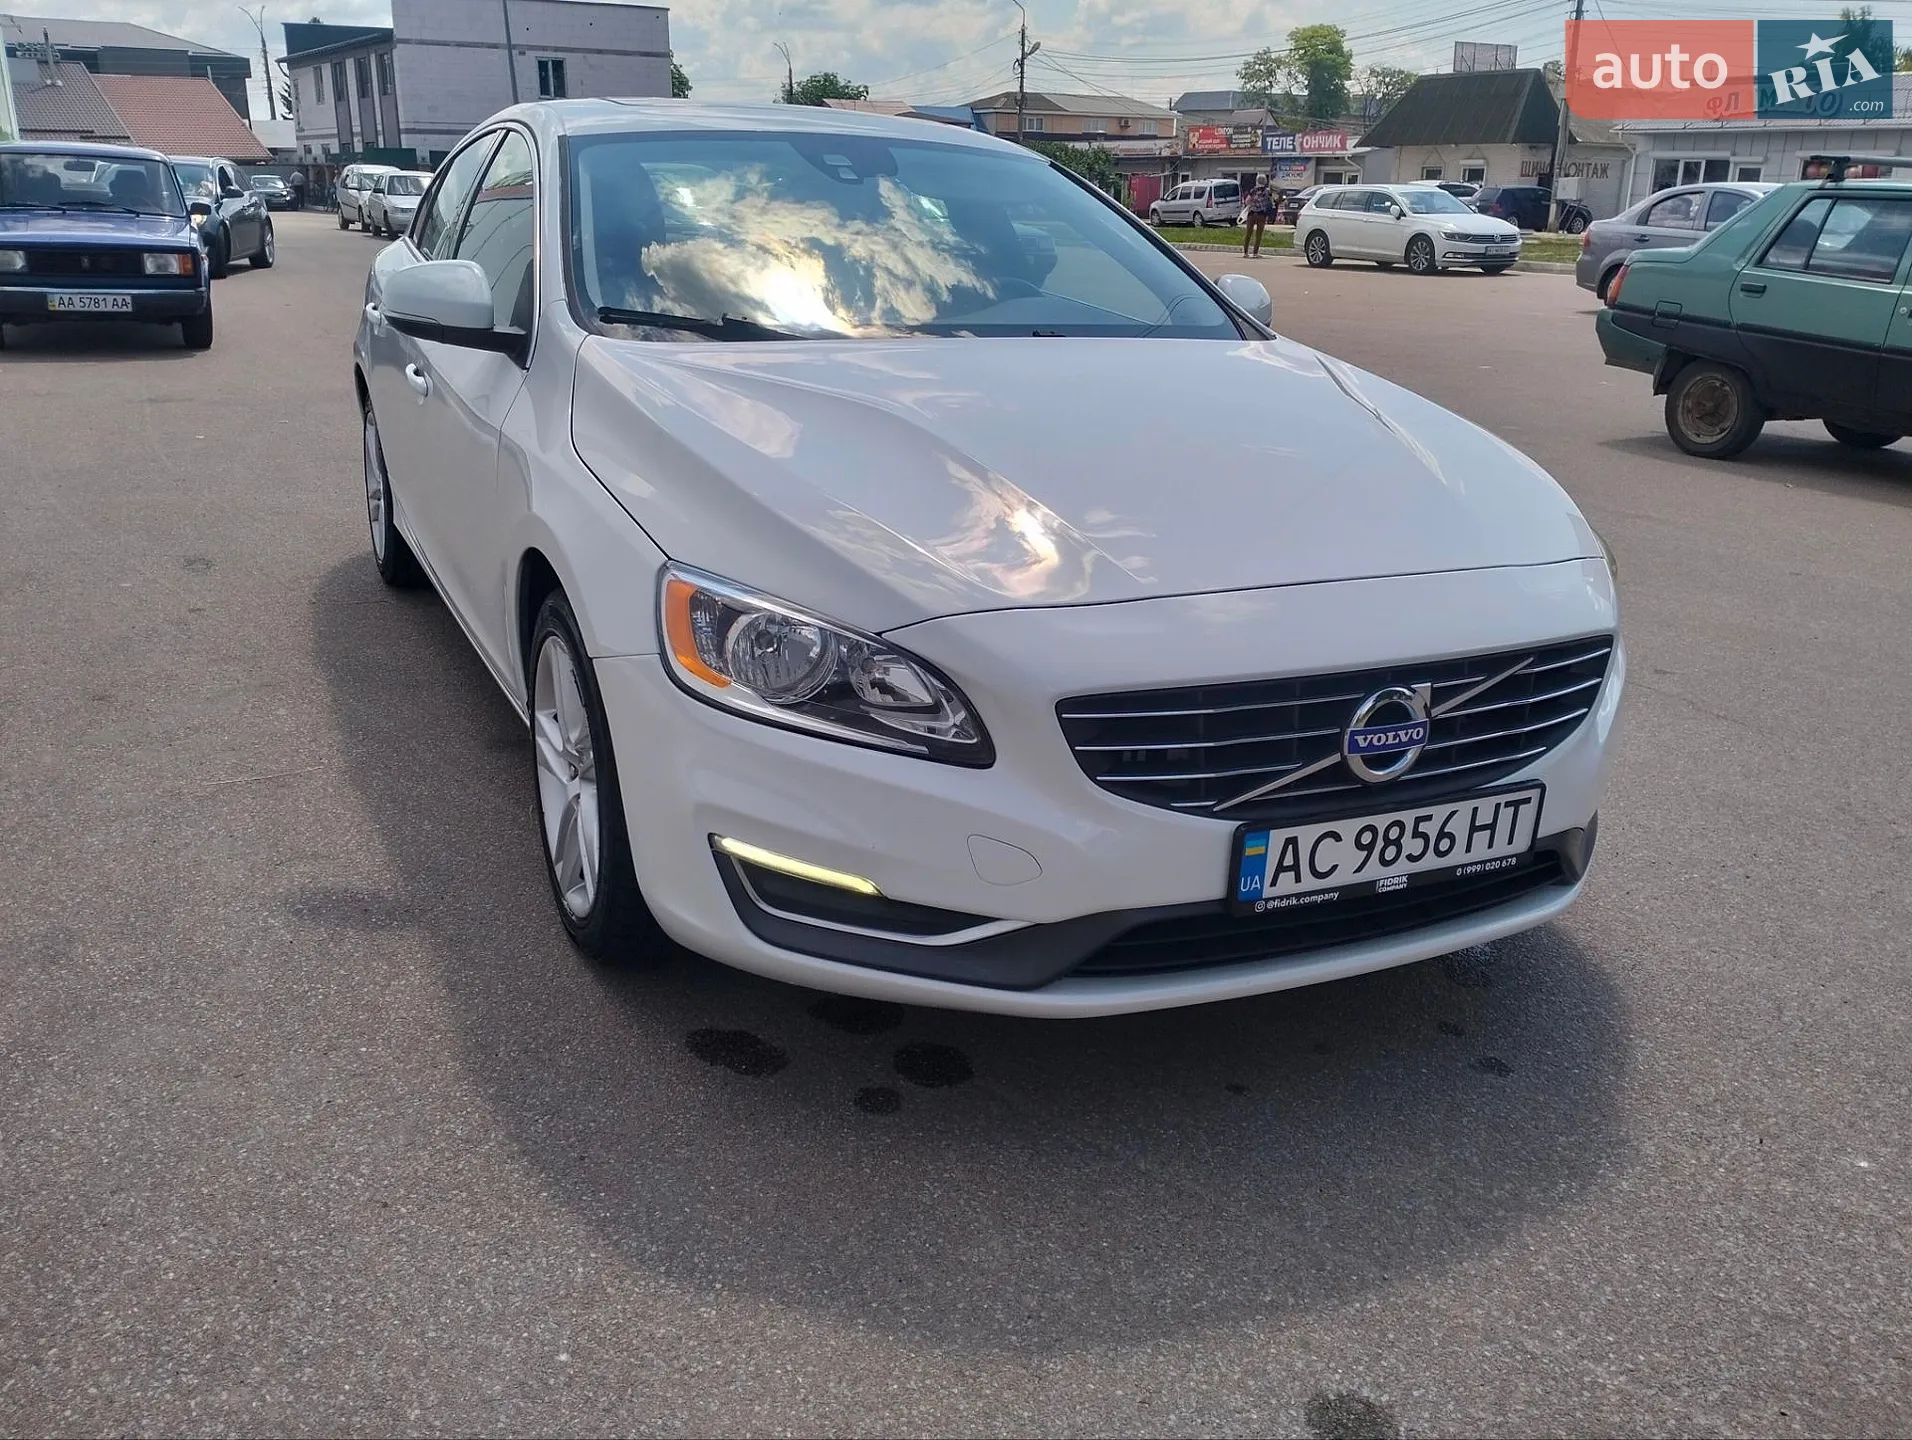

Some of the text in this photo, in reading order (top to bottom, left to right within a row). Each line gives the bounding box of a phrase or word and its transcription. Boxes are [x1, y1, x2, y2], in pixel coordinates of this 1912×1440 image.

[57, 296, 129, 309] AA 5781 AA
[1354, 727, 1424, 747] VOLVO
[1269, 796, 1532, 887] AC 9856 HT
[1240, 875, 1261, 892] UA
[1378, 883, 1407, 893] COMPANY
[1379, 875, 1408, 887] FIDRIK
